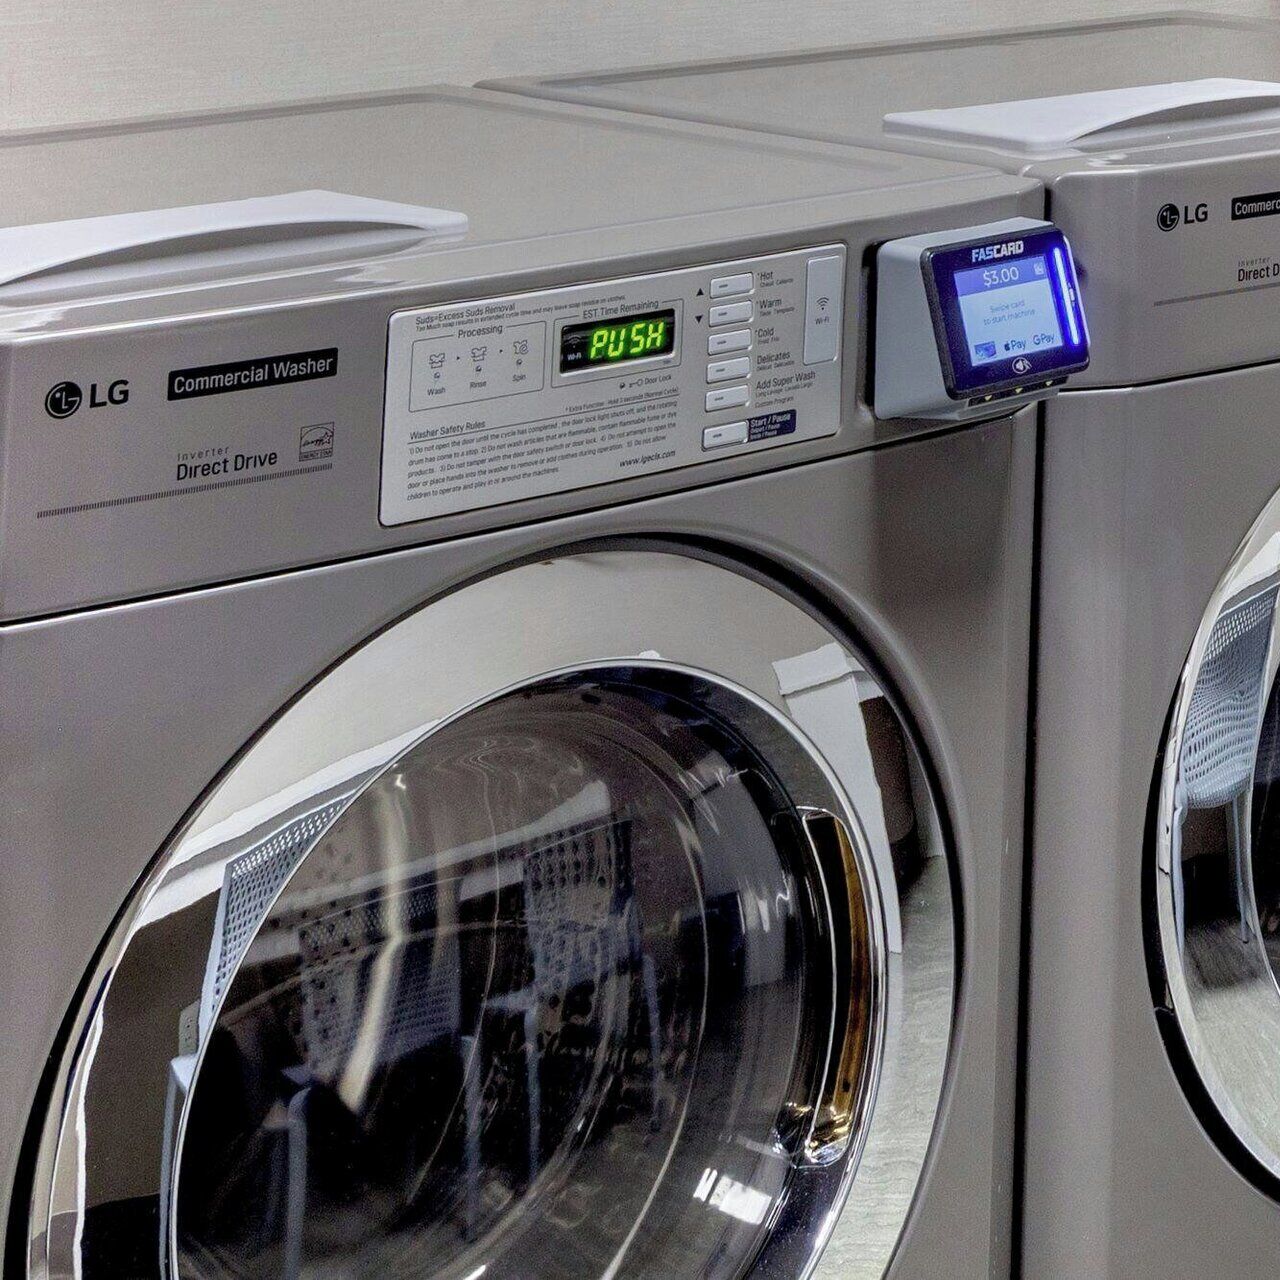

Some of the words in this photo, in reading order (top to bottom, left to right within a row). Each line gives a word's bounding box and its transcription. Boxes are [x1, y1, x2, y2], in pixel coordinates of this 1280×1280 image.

[1184, 203, 1208, 225] LG
[972, 240, 1024, 262] FASCARD
[983, 267, 1019, 288] $3.00
[1238, 265, 1270, 282] Direct
[465, 308, 484, 318] Suds
[485, 303, 515, 316] Removal
[601, 306, 619, 316] Time
[620, 300, 659, 312] Remaining
[458, 325, 503, 339] Processing
[590, 322, 664, 359] PUSH
[757, 352, 791, 365] Delicates
[173, 363, 268, 394] Commercial
[273, 357, 334, 380] Washer
[756, 381, 771, 390] Add
[773, 376, 794, 387] Super
[795, 370, 816, 382] Wash
[90, 380, 129, 408] LG
[427, 387, 446, 396] Wash
[410, 427, 439, 440] Washer
[440, 423, 465, 436] Safety
[466, 420, 486, 430] Rules
[177, 445, 230, 461] Inverter
[176, 456, 230, 481] Direct
[233, 451, 278, 472] Drive
